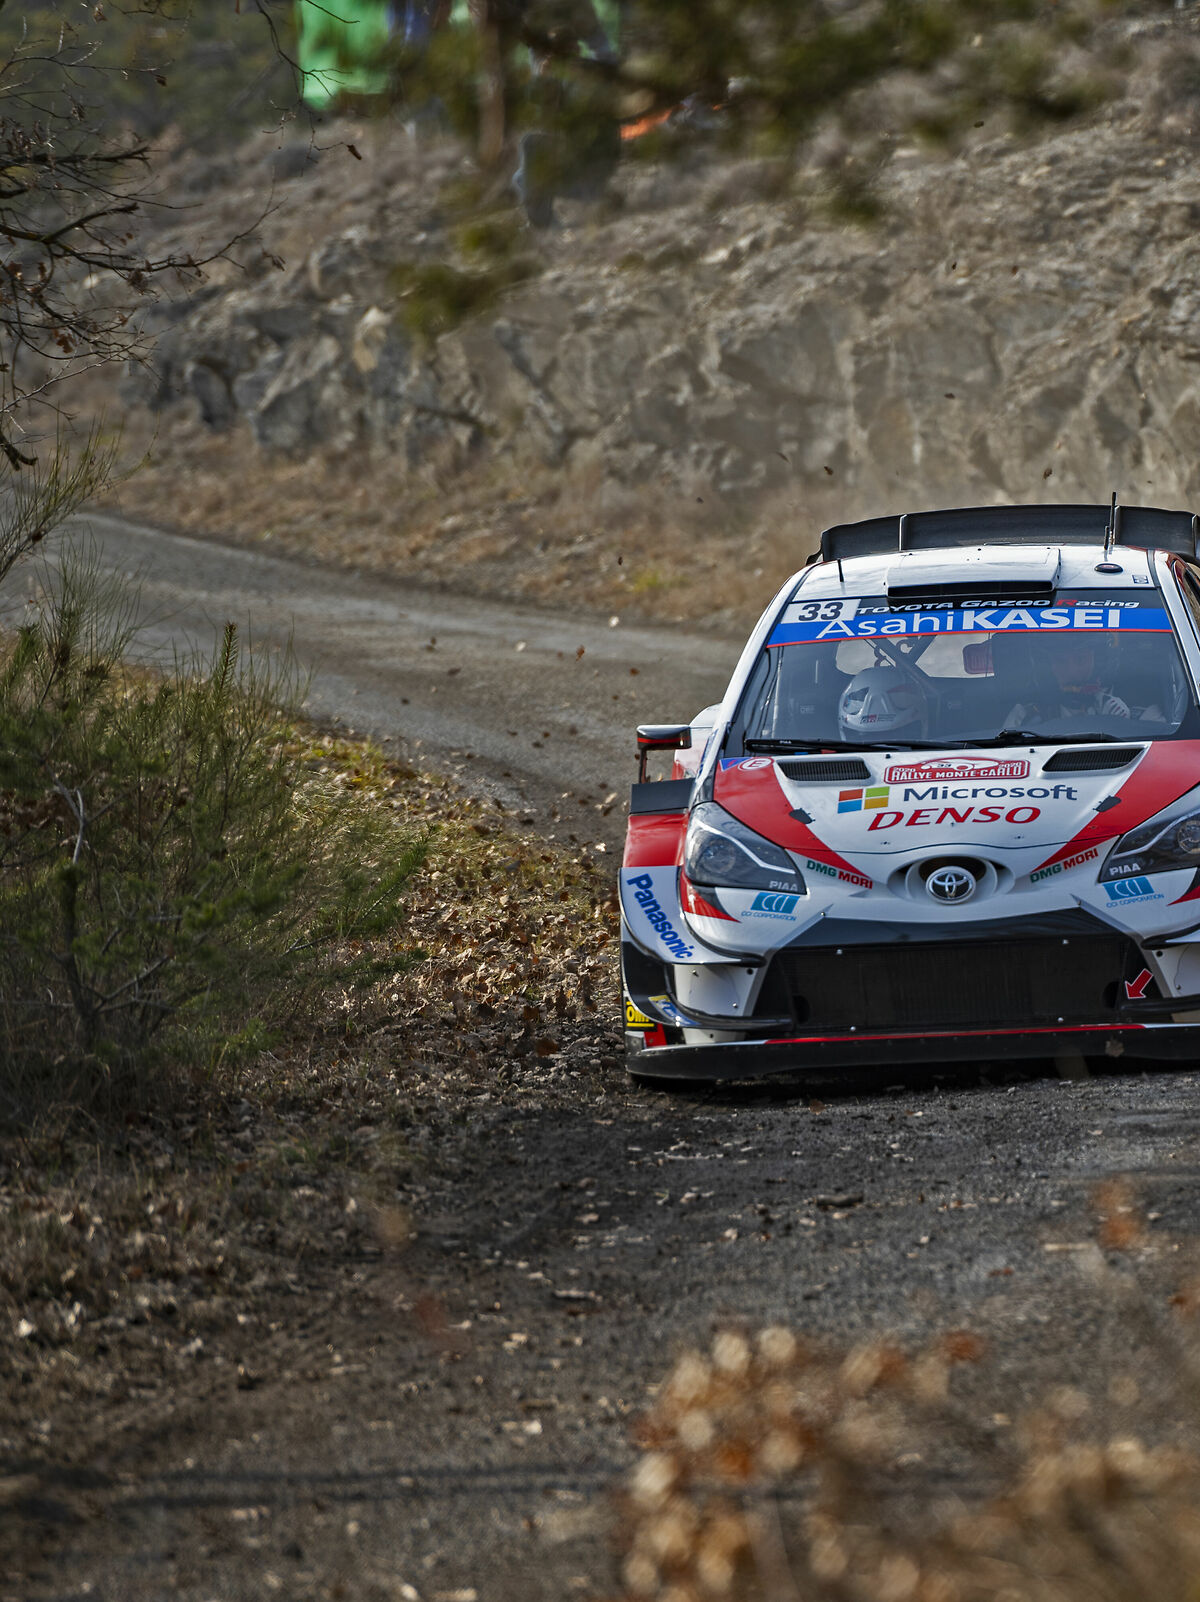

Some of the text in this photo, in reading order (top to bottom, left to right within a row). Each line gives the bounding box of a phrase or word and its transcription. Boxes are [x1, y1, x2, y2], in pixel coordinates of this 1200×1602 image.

[798, 601, 844, 622] 33
[857, 599, 1140, 615] TOYOTA GAZOO Racing
[891, 770, 933, 781] RALLYE
[903, 784, 1078, 802] Microsoft
[867, 806, 1041, 831] DENSO
[807, 859, 873, 889] DMG MORI
[1029, 848, 1099, 884] DMG MORI
[1109, 862, 1141, 876] PIAA
[769, 880, 798, 891] PIAA
[626, 873, 694, 959] Panasonic
[626, 1005, 650, 1023] OM
